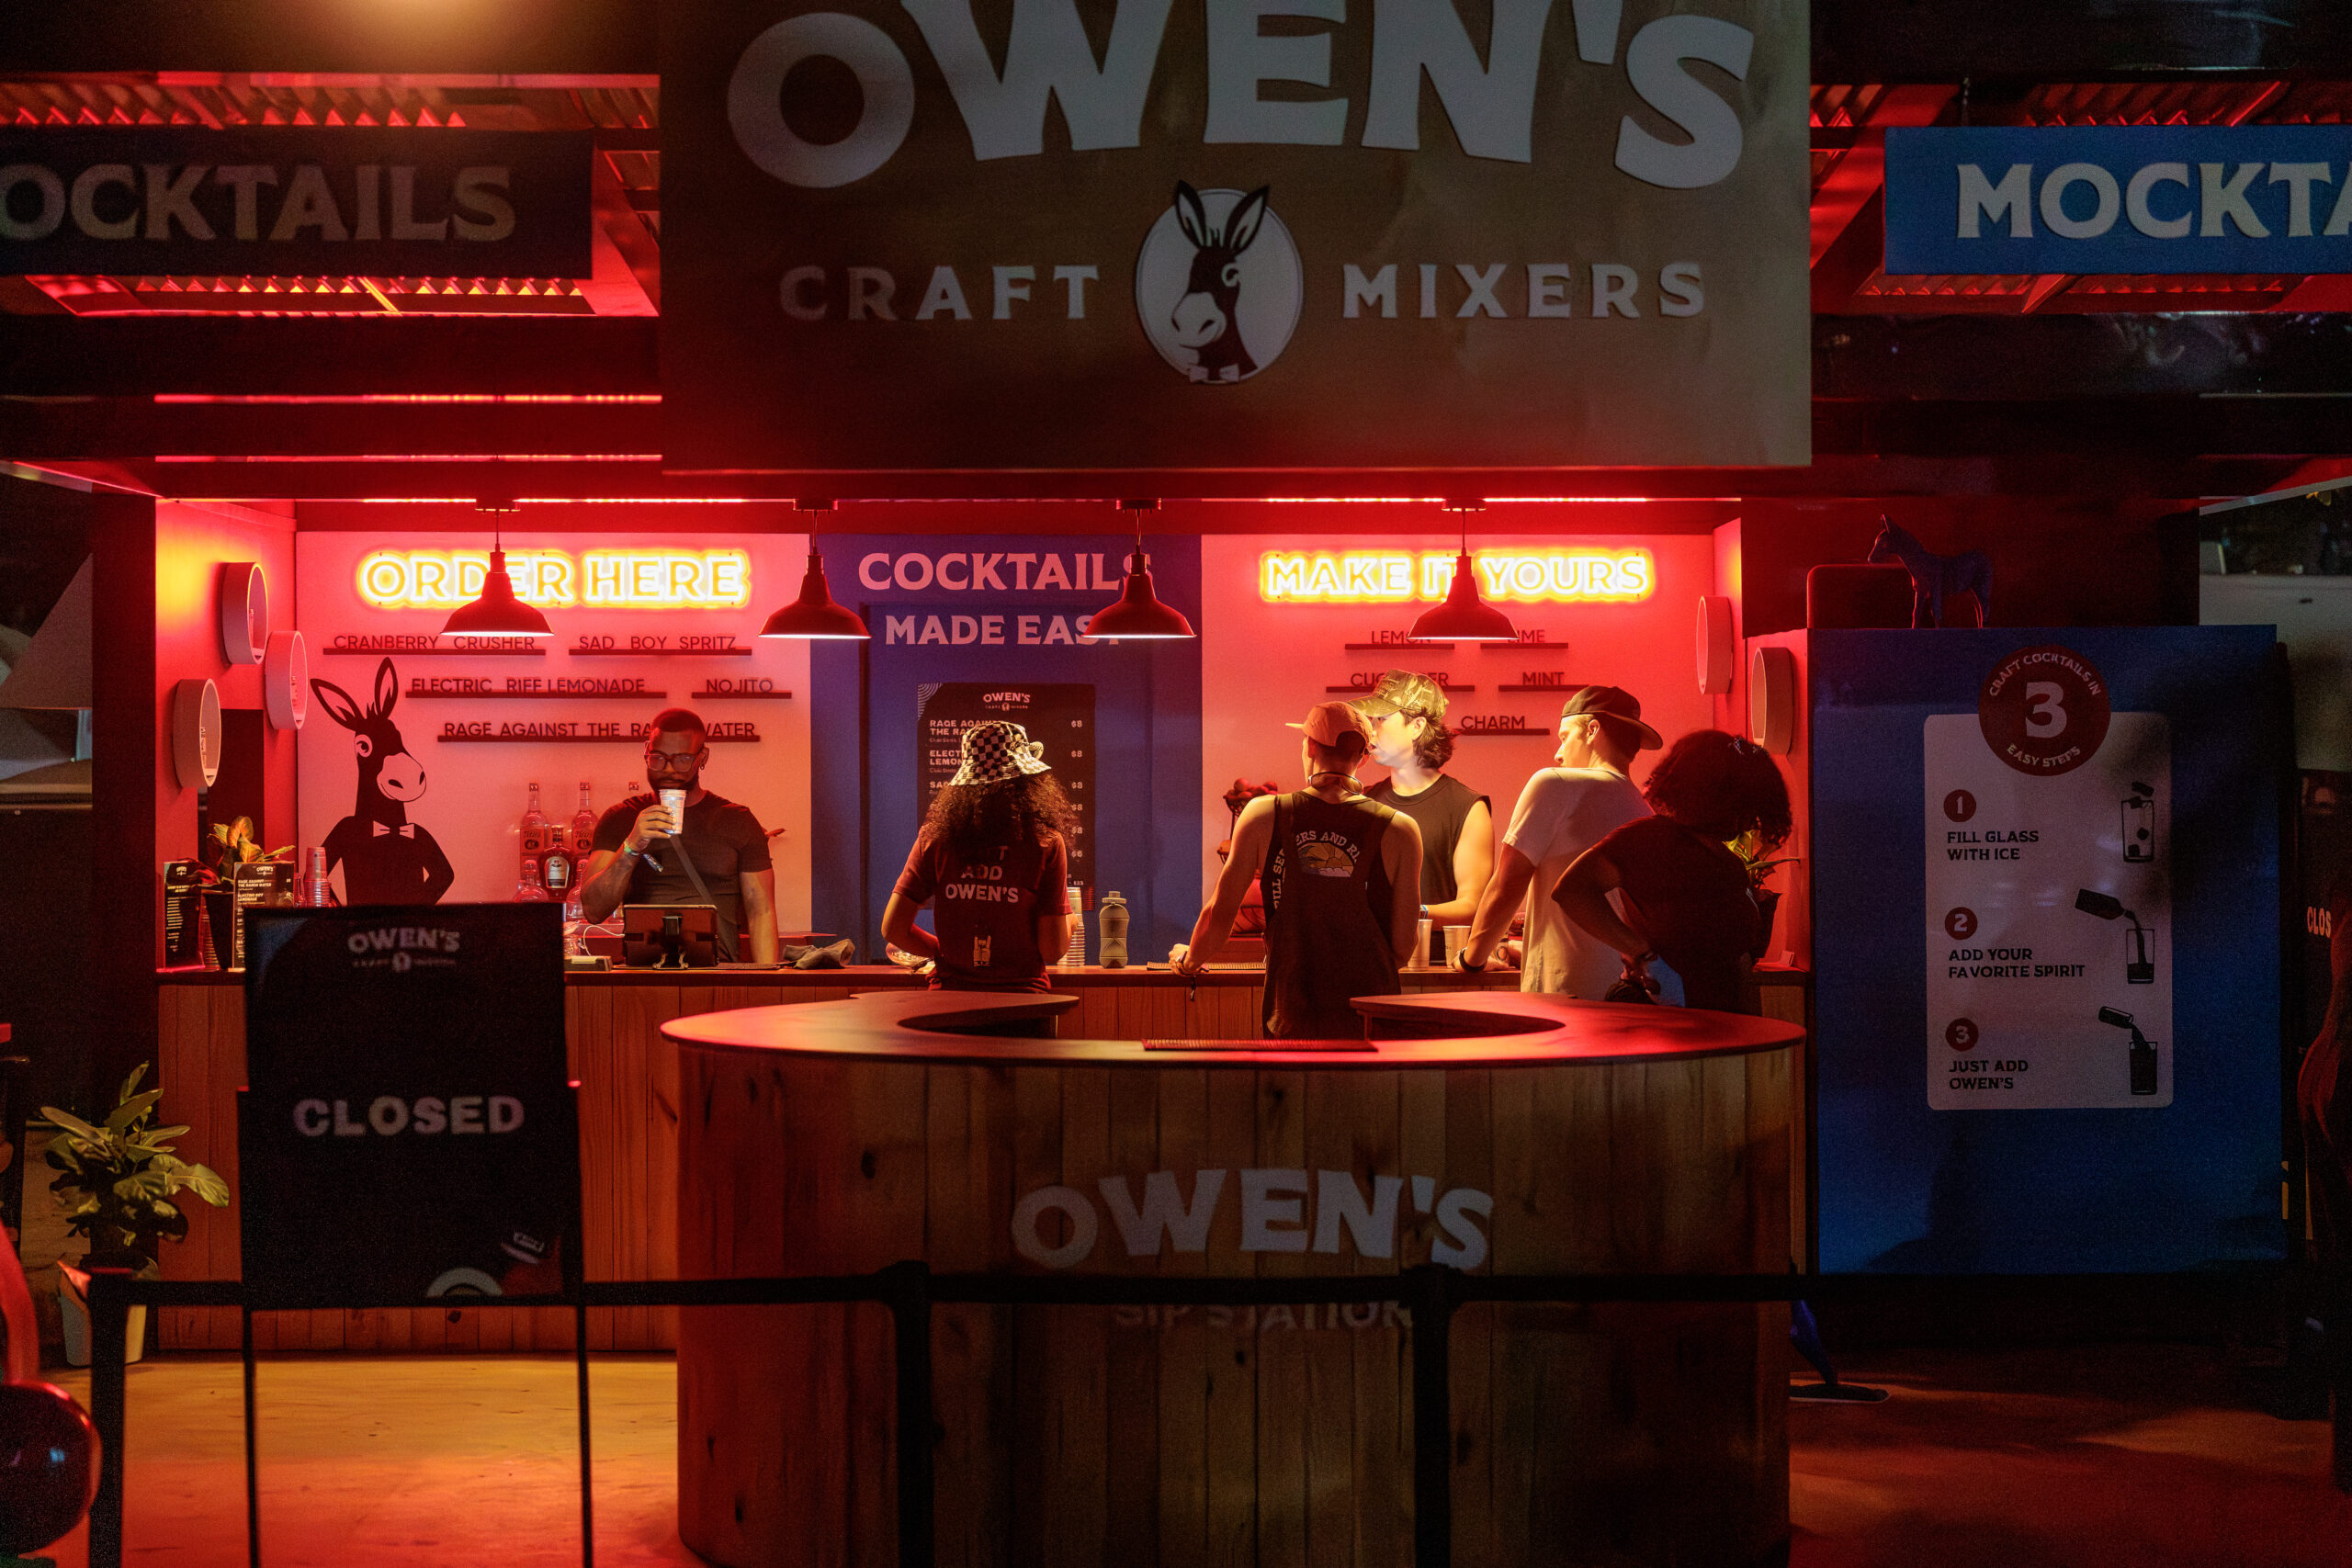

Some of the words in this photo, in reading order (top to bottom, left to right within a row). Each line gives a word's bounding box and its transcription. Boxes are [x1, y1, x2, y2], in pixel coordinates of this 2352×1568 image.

[727, 0, 1755, 188] OWEN'S
[778, 263, 1100, 321] CRAFT
[1340, 263, 1706, 320] MIXERS
[365, 556, 574, 603] ORDER
[585, 556, 743, 603] HERE
[1266, 557, 1412, 596] MAKE
[1422, 557, 1458, 597] IT
[1480, 557, 1648, 595] YOURS
[885, 615, 1005, 646] MADE
[1017, 615, 1119, 646] EAS
[1371, 630, 1431, 644] LEM
[1508, 630, 1545, 644] IME
[334, 635, 438, 650] CRANBERRY
[453, 635, 536, 650] CRUSHER
[579, 635, 615, 649] SAD
[630, 635, 668, 649] BOY
[679, 635, 737, 649] SPRITZ
[1522, 672, 1564, 686] MINT
[1989, 660, 2020, 697] CRAFT
[2023, 652, 2090, 683] COCKTAILS
[2087, 680, 2101, 696] IN
[412, 678, 493, 693] ELECTRIC
[548, 679, 645, 693] LEMONADE
[706, 679, 774, 694] NOJITO
[983, 692, 1031, 704] OWEN'S
[2025, 681, 2067, 739] 3
[444, 723, 492, 736] RAGE
[500, 723, 578, 736] AGAINST
[588, 723, 620, 736] THE
[706, 722, 755, 736] ATER
[1460, 716, 1525, 730] CHARM
[930, 728, 951, 736] THE
[2007, 742, 2039, 766] EASY
[2042, 746, 2081, 768] STEPS
[1956, 796, 1963, 815] 1
[1320, 831, 1348, 846] AND
[1947, 831, 1981, 843] FILL
[1985, 830, 2040, 843] GLASS
[1947, 848, 1990, 861] WITH
[1995, 848, 2020, 860] ICE
[961, 865, 1003, 881] ADD
[944, 884, 1019, 903] OWEN'S
[1954, 914, 1968, 932] 2
[2308, 906, 2332, 938] CLOS
[347, 927, 460, 953] OWEN'S
[1949, 949, 1984, 961] ADD
[1987, 948, 2032, 961] YOUR
[1949, 965, 2030, 979] FAVORITE
[2033, 964, 2086, 978] SPIRIT
[1955, 1025, 1970, 1043] 3
[1949, 1060, 1989, 1073] JUST
[1995, 1060, 2029, 1073] ADD
[1949, 1077, 2014, 1090] OWEN'S
[292, 1094, 526, 1138] CLOSED
[1011, 1168, 1495, 1271] OWEN'S
